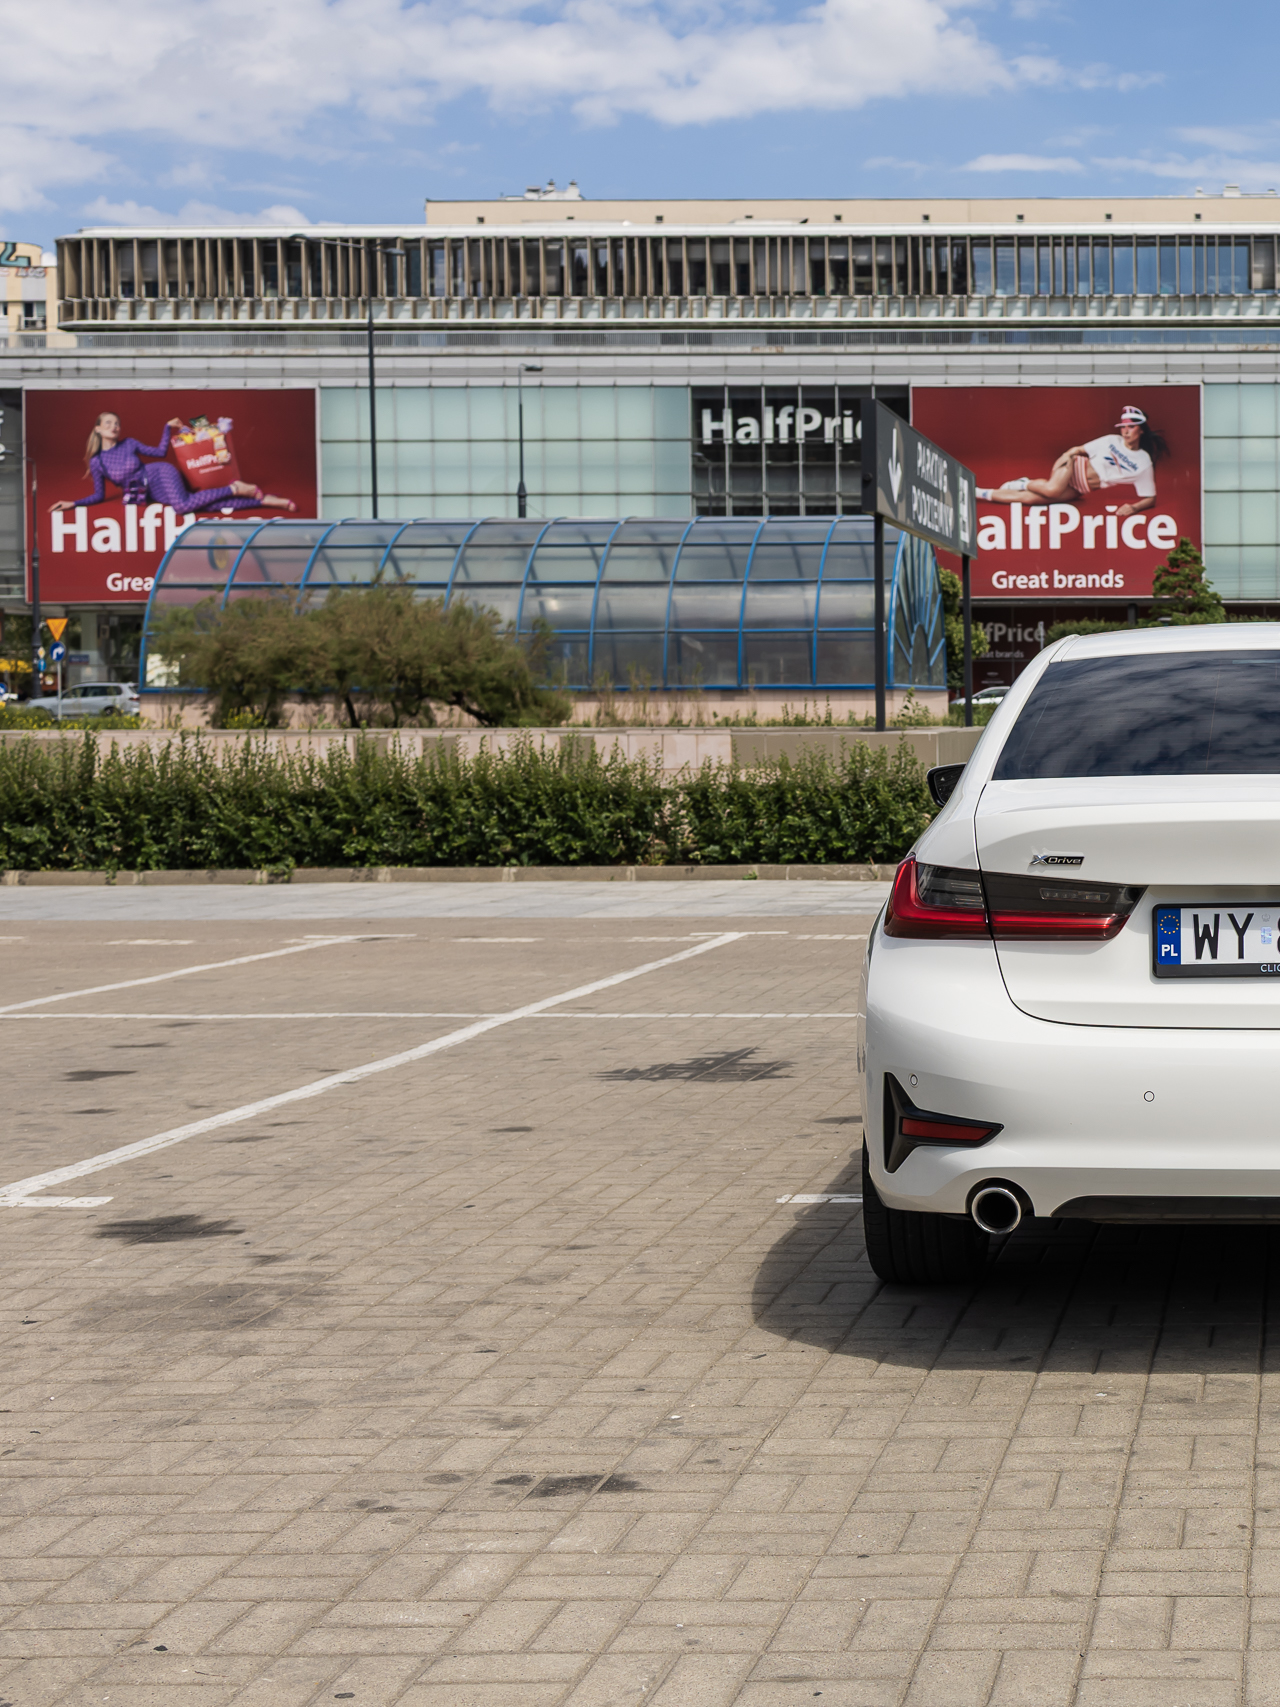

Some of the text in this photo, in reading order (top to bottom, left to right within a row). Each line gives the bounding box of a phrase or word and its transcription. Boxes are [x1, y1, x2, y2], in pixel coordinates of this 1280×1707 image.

[702, 405, 862, 444] HalfPri
[977, 502, 1178, 550] alfPrice
[106, 573, 153, 592] Grea
[991, 569, 1124, 589] Great brands
[984, 622, 1046, 642] fPrice
[1161, 944, 1178, 957] PL
[1193, 913, 1255, 960] WY
